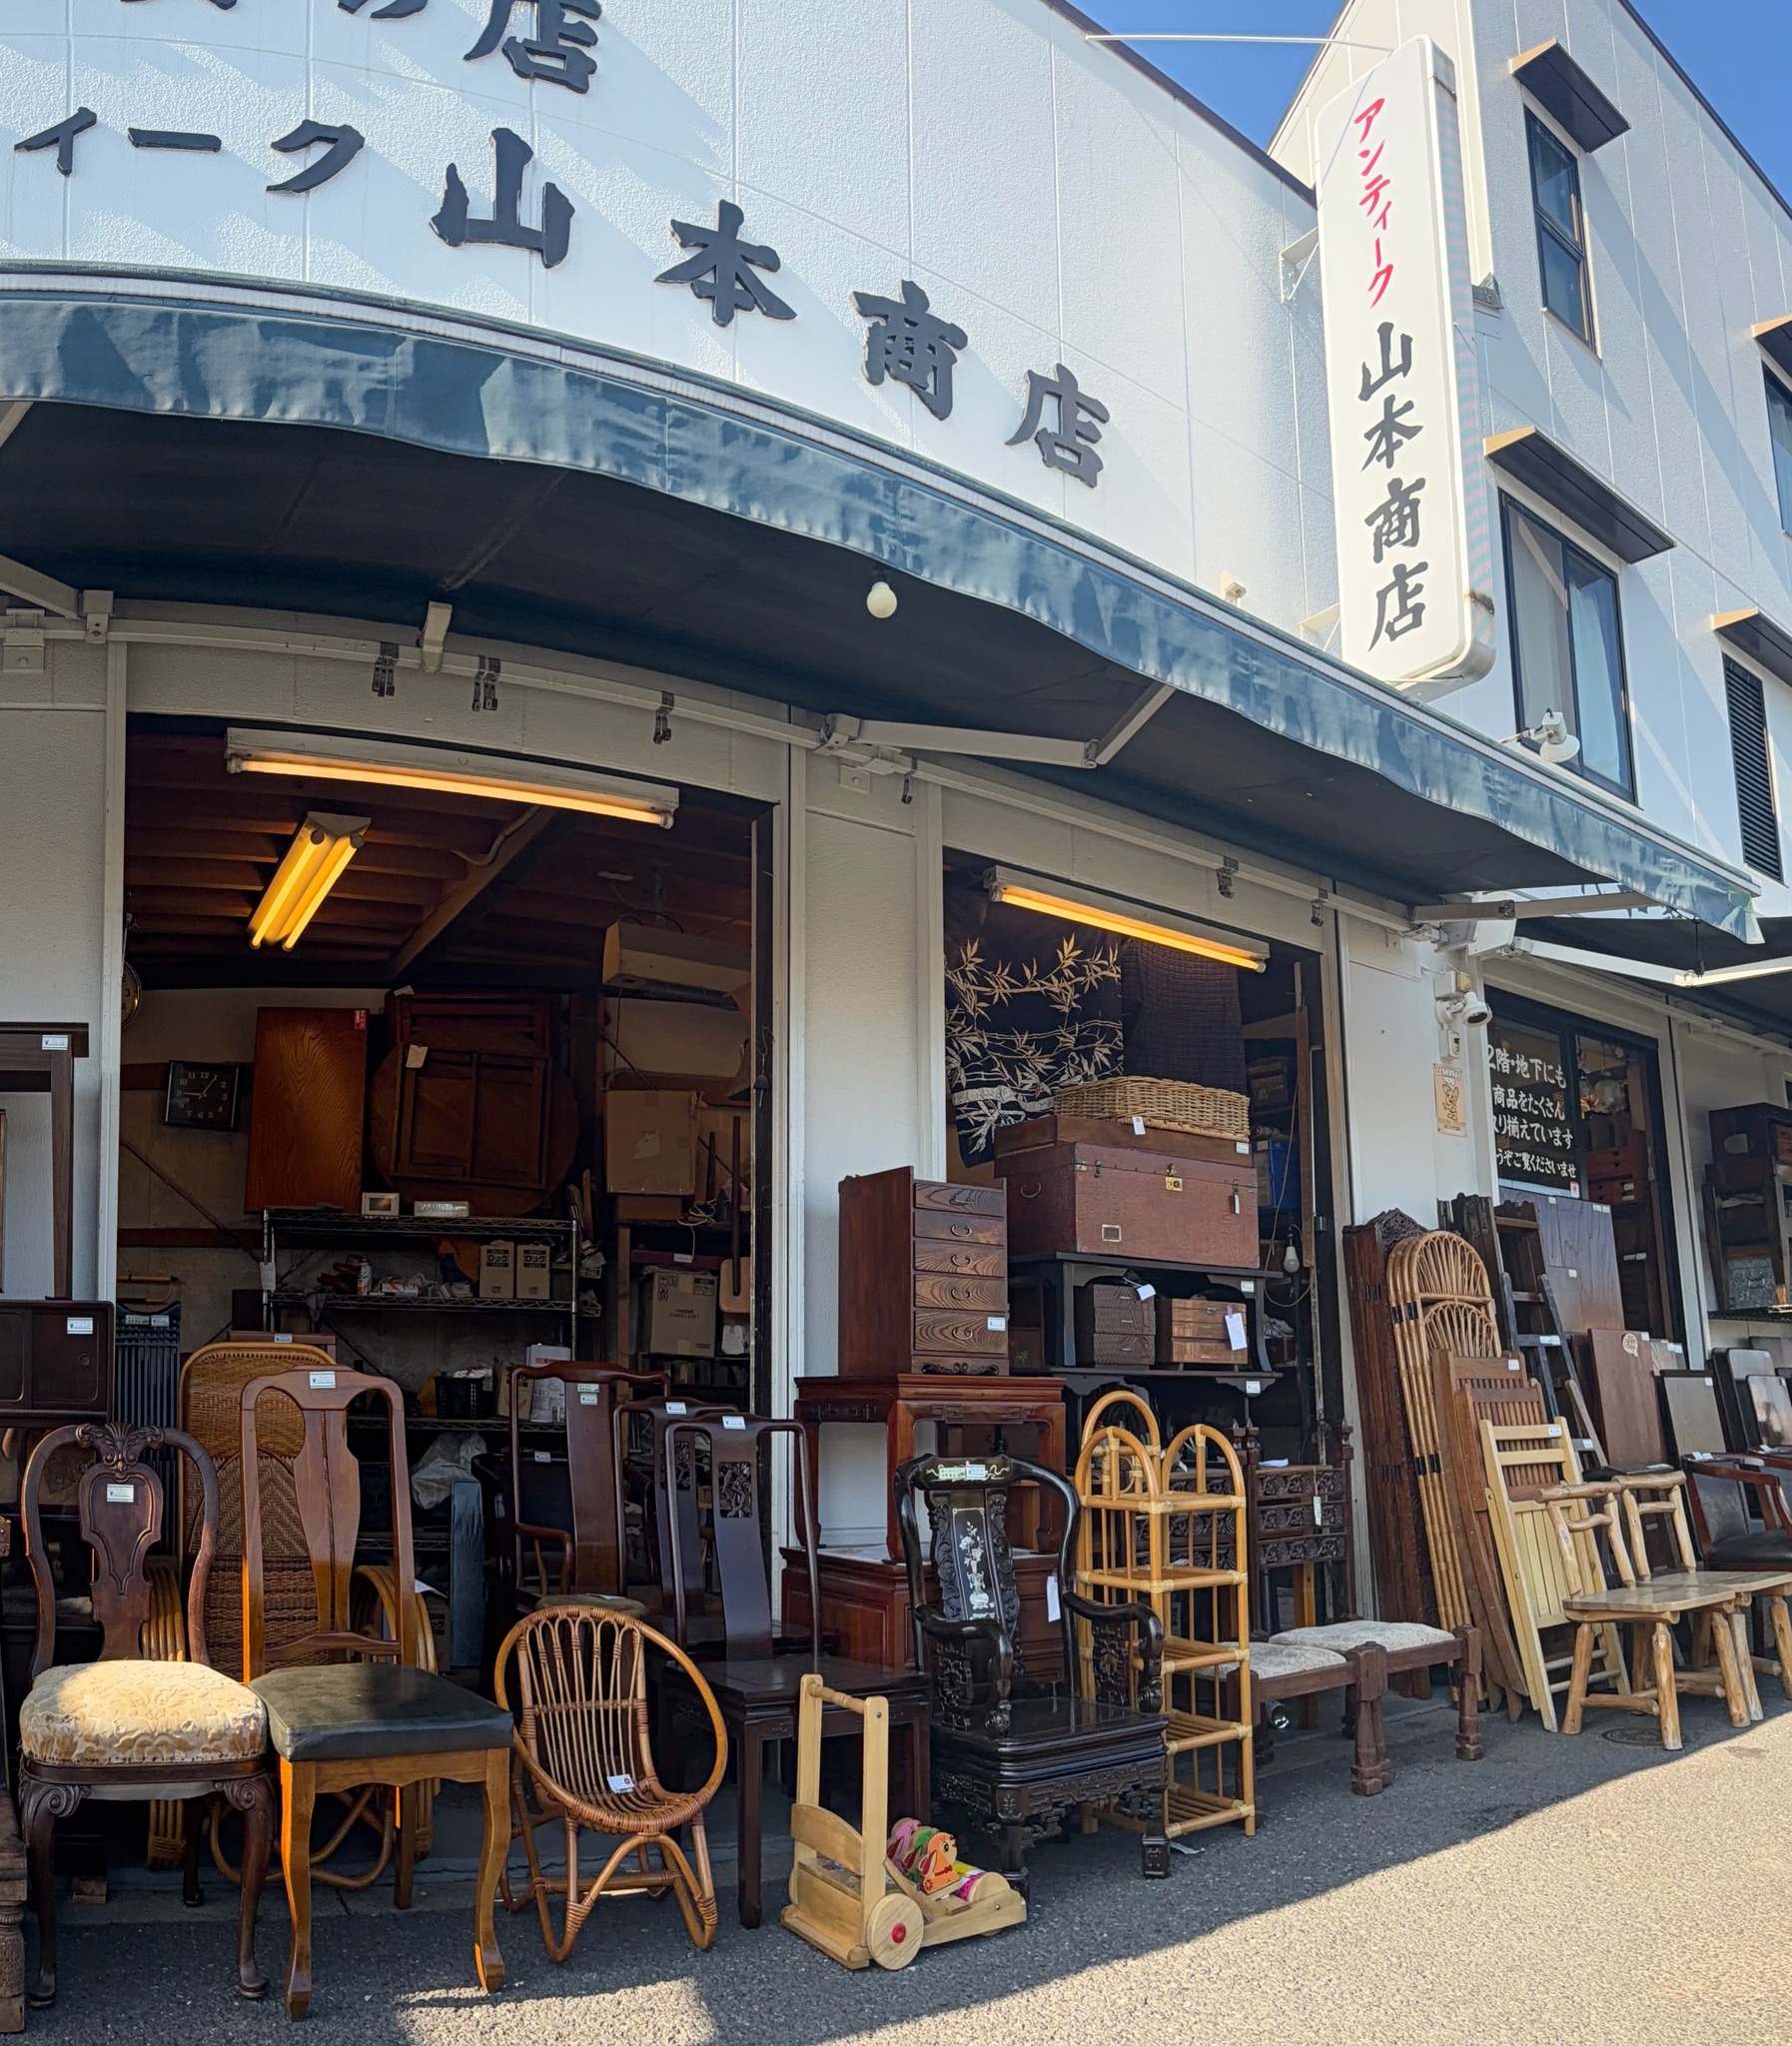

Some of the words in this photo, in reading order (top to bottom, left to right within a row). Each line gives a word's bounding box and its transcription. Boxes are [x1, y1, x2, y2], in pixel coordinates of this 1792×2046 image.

[1353, 98, 1394, 309] アンティーク
[1357, 322, 1428, 652] 山本商店
[1492, 1084, 1566, 1122] 商品をたくさん
